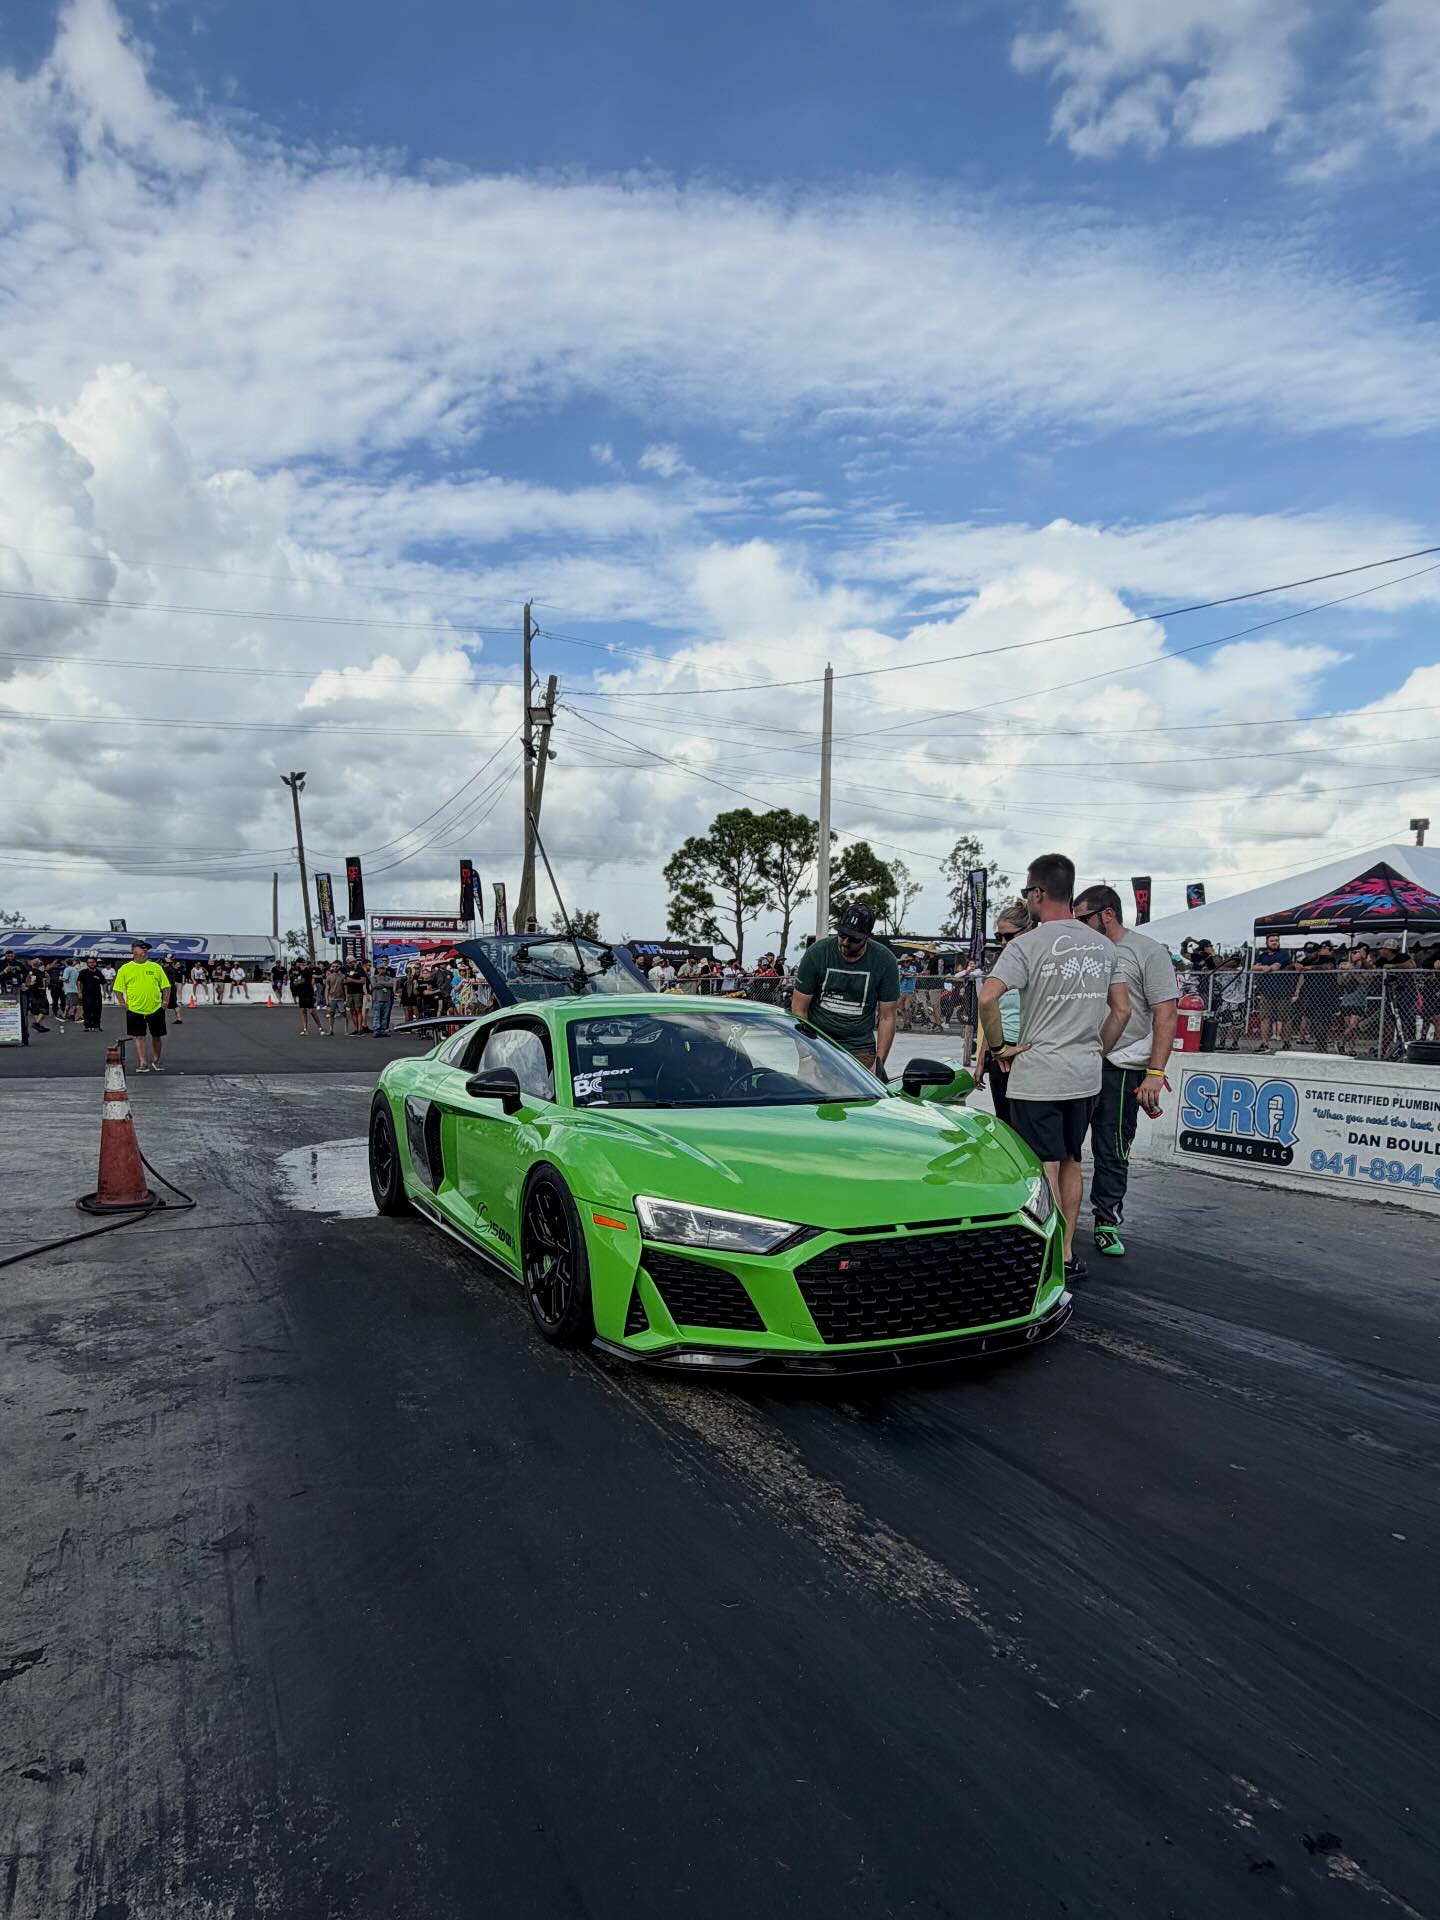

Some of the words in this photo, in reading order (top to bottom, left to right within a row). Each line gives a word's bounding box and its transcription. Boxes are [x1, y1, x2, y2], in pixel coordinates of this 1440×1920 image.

[386, 920, 424, 929] WINNER'S
[426, 920, 455, 929] CIRCLE
[73, 949, 99, 958] UPR
[573, 1068, 633, 1081] dodson
[1305, 1089, 1335, 1101] STATE
[1337, 1092, 1390, 1106] CERTIFIED
[1181, 1073, 1300, 1149] SRQ
[1346, 1114, 1364, 1124] you
[1366, 1115, 1390, 1126] need
[1391, 1116, 1408, 1128] the
[1348, 1132, 1381, 1147] DAN
[1187, 1137, 1254, 1155] PLUMBING
[1263, 1148, 1288, 1160] LLC
